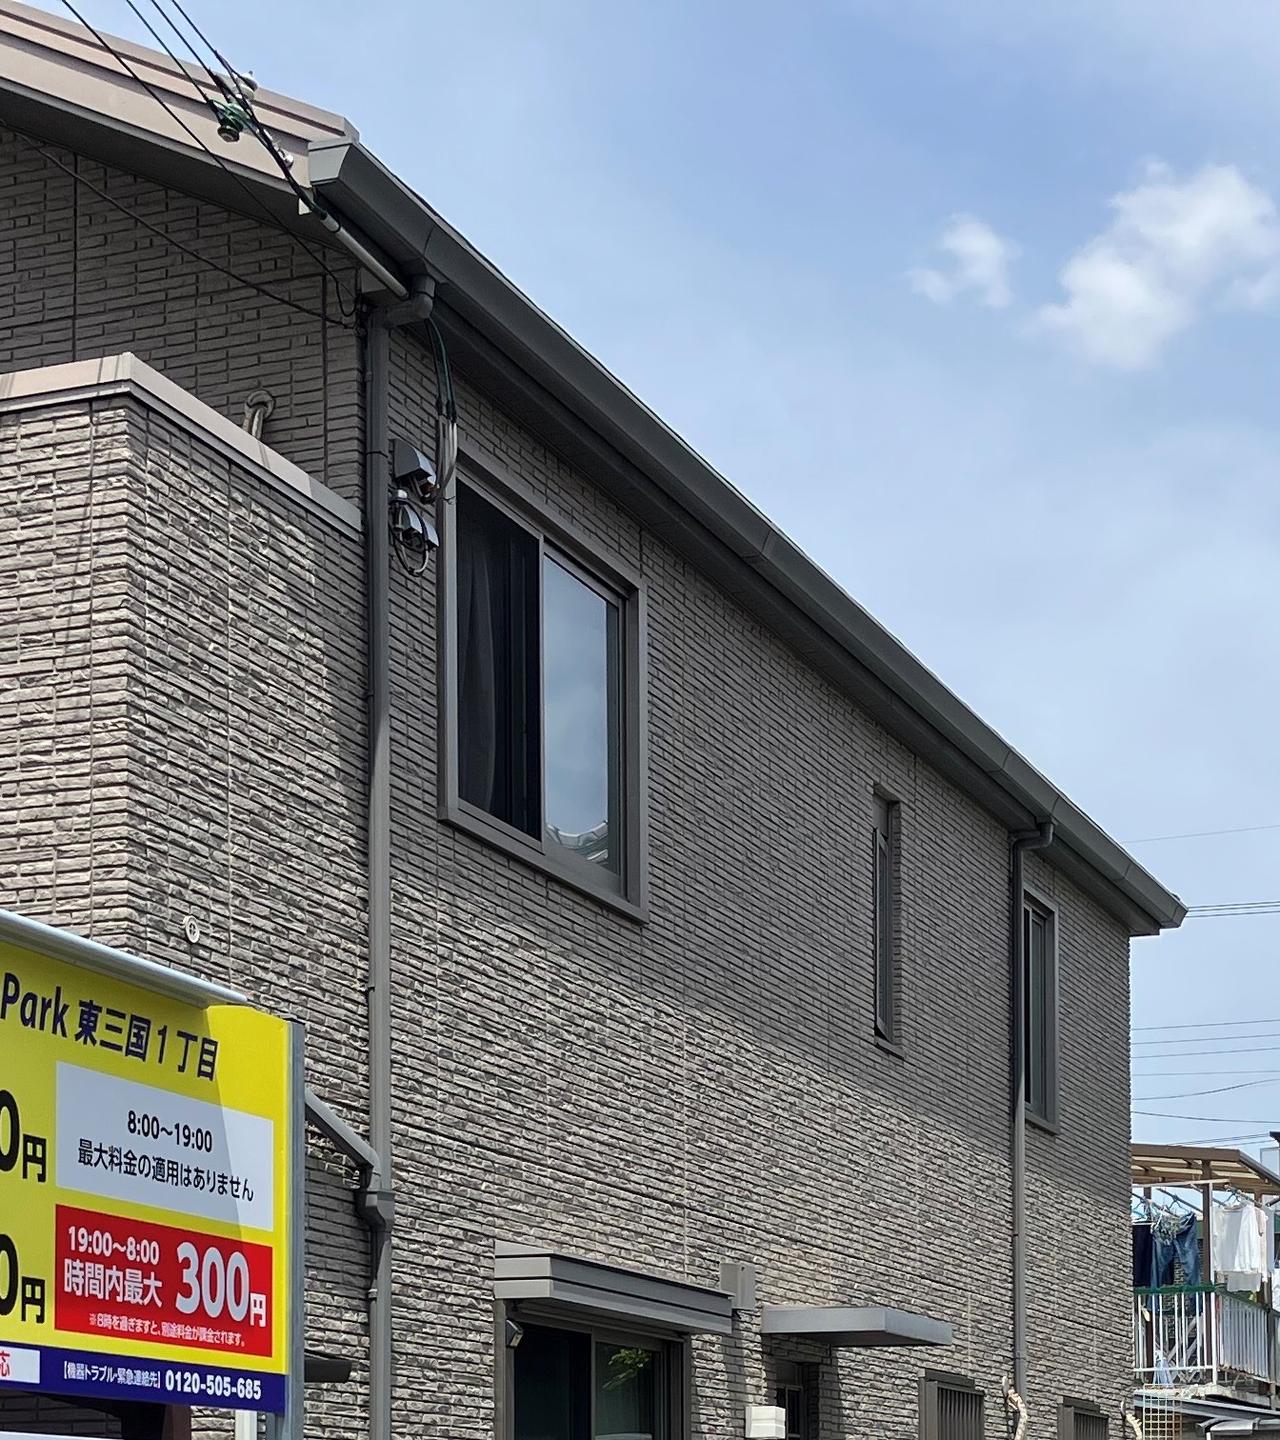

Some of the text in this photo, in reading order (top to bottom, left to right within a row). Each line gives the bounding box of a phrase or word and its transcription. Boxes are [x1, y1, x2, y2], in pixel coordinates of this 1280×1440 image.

[78, 1138, 254, 1202] 最大料金の適用はありません
[63, 1257, 163, 1308] 時間内最大
[175, 1241, 267, 1327] 300円
[165, 1369, 262, 1400] 0120-505-685
